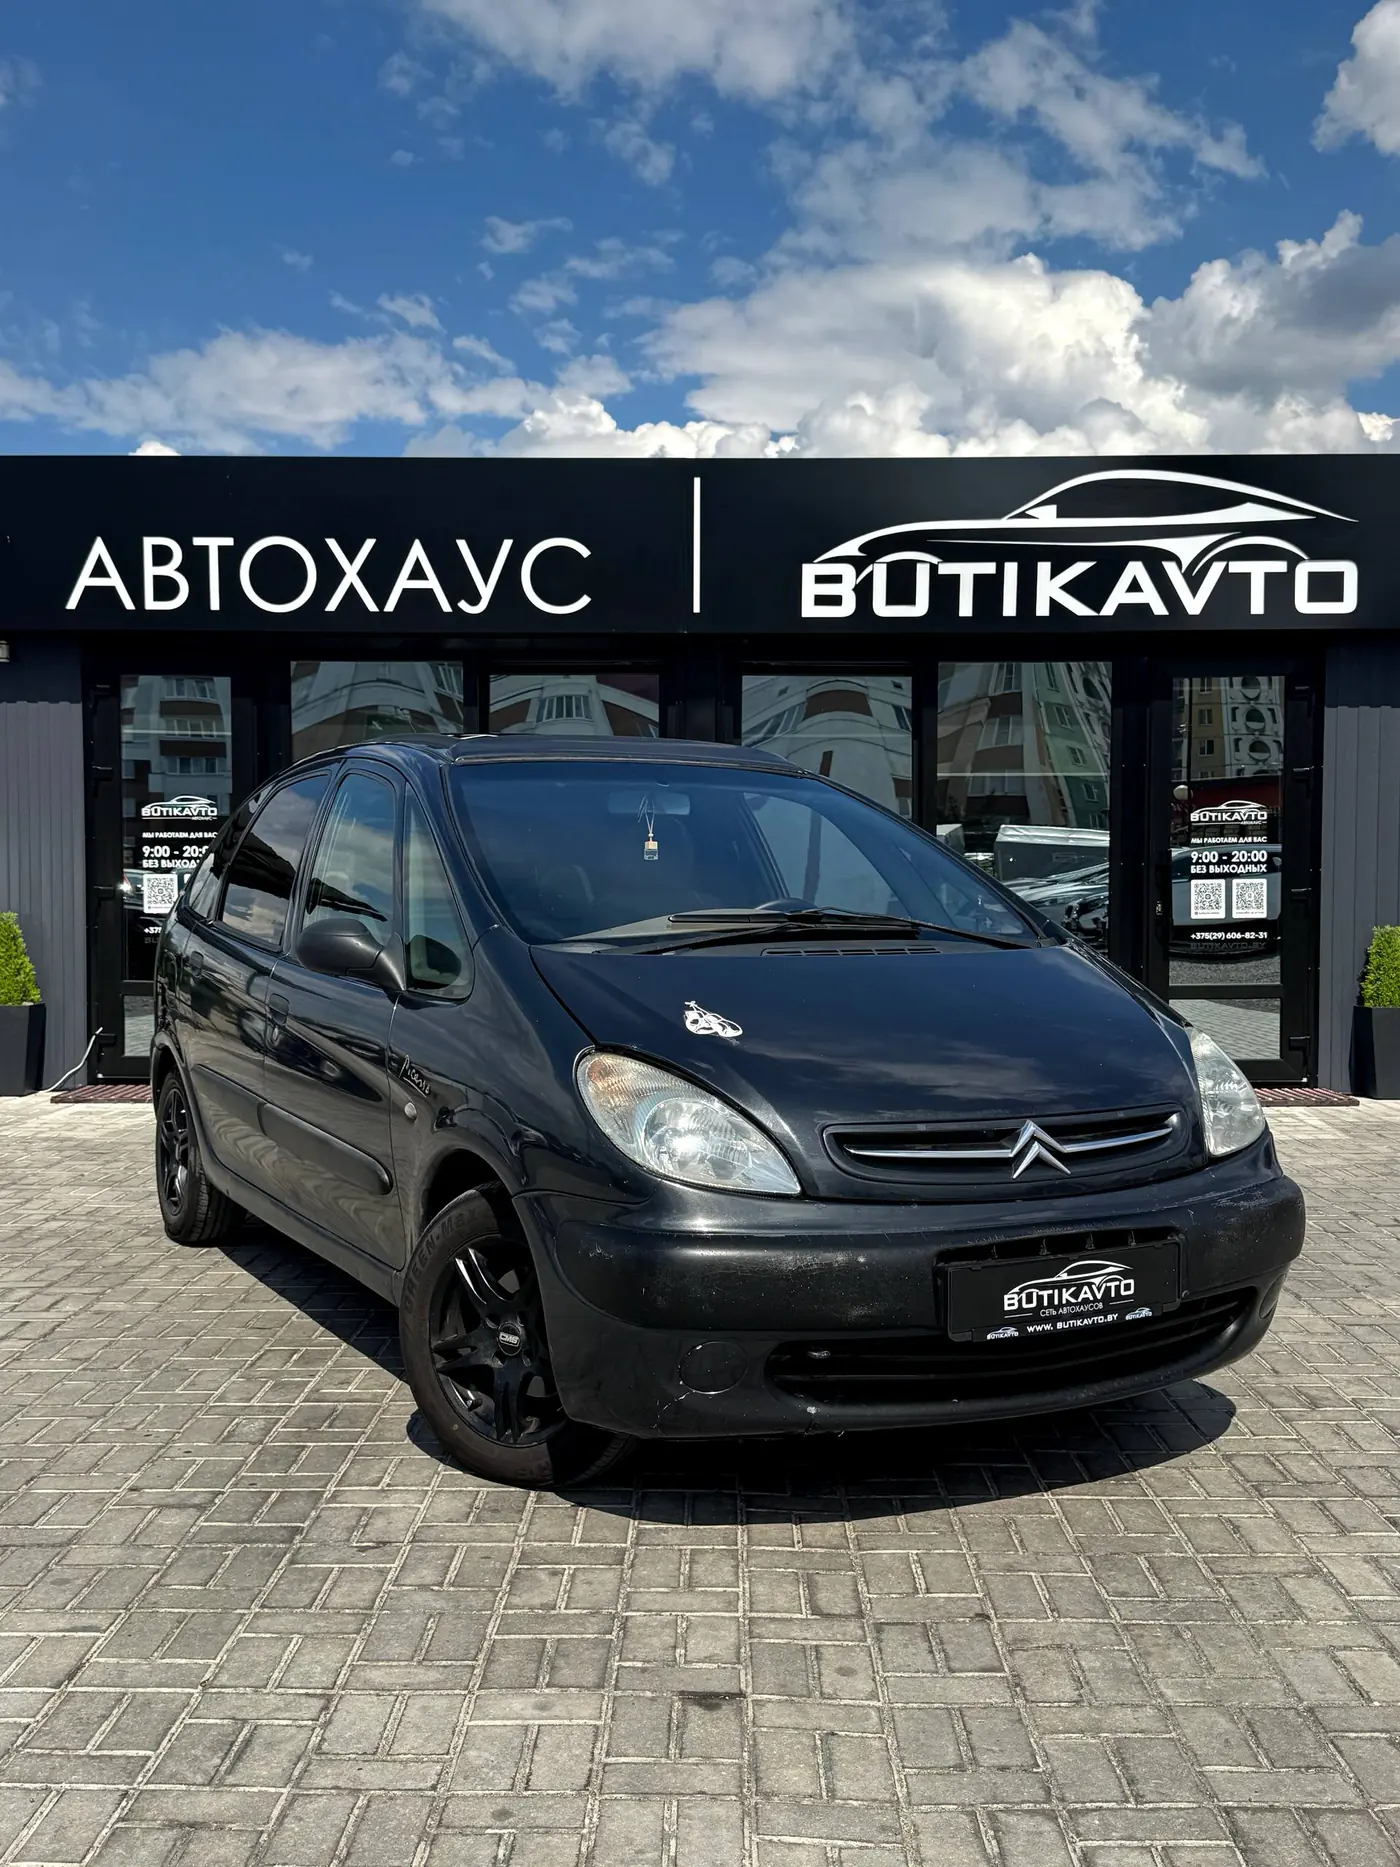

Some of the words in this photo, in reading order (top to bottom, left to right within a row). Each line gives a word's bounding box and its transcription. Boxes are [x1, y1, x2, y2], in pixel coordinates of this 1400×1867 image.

[65, 535, 592, 616] АВТОХАУС
[801, 558, 1358, 618] BUTIKAVTO
[141, 806, 218, 817] BUTIKAVTO
[1190, 810, 1268, 822] BUTIKAVTO
[142, 831, 155, 839] МЫ
[155, 831, 190, 839] РАБОТАЕМ
[189, 831, 203, 839] ДЛЯ
[1203, 836, 1238, 844] РАБОТАЕМ
[1238, 836, 1252, 844] ДЛЯ
[142, 845, 171, 858] 9:00
[182, 845, 209, 858] 20:
[1190, 850, 1219, 863] 9:00
[1231, 850, 1268, 863] 20:00
[142, 859, 159, 869] БЕЗ
[161, 859, 200, 869] ВЫХОД
[1190, 865, 1207, 874] БЕЗ
[1209, 864, 1268, 874] ВЫХОДНЫХ
[1190, 932, 1225, 941] +375(29)
[1226, 931, 1268, 940] 606-82-31
[1003, 1278, 1135, 1311] BUTIKAVTO
[1039, 1308, 1057, 1317] СЕТЬ
[1058, 1302, 1104, 1316] АВТОХАУСОВ
[1056, 1313, 1119, 1330] BUTIKAVTO.BY
[499, 1332, 519, 1344] CMS
